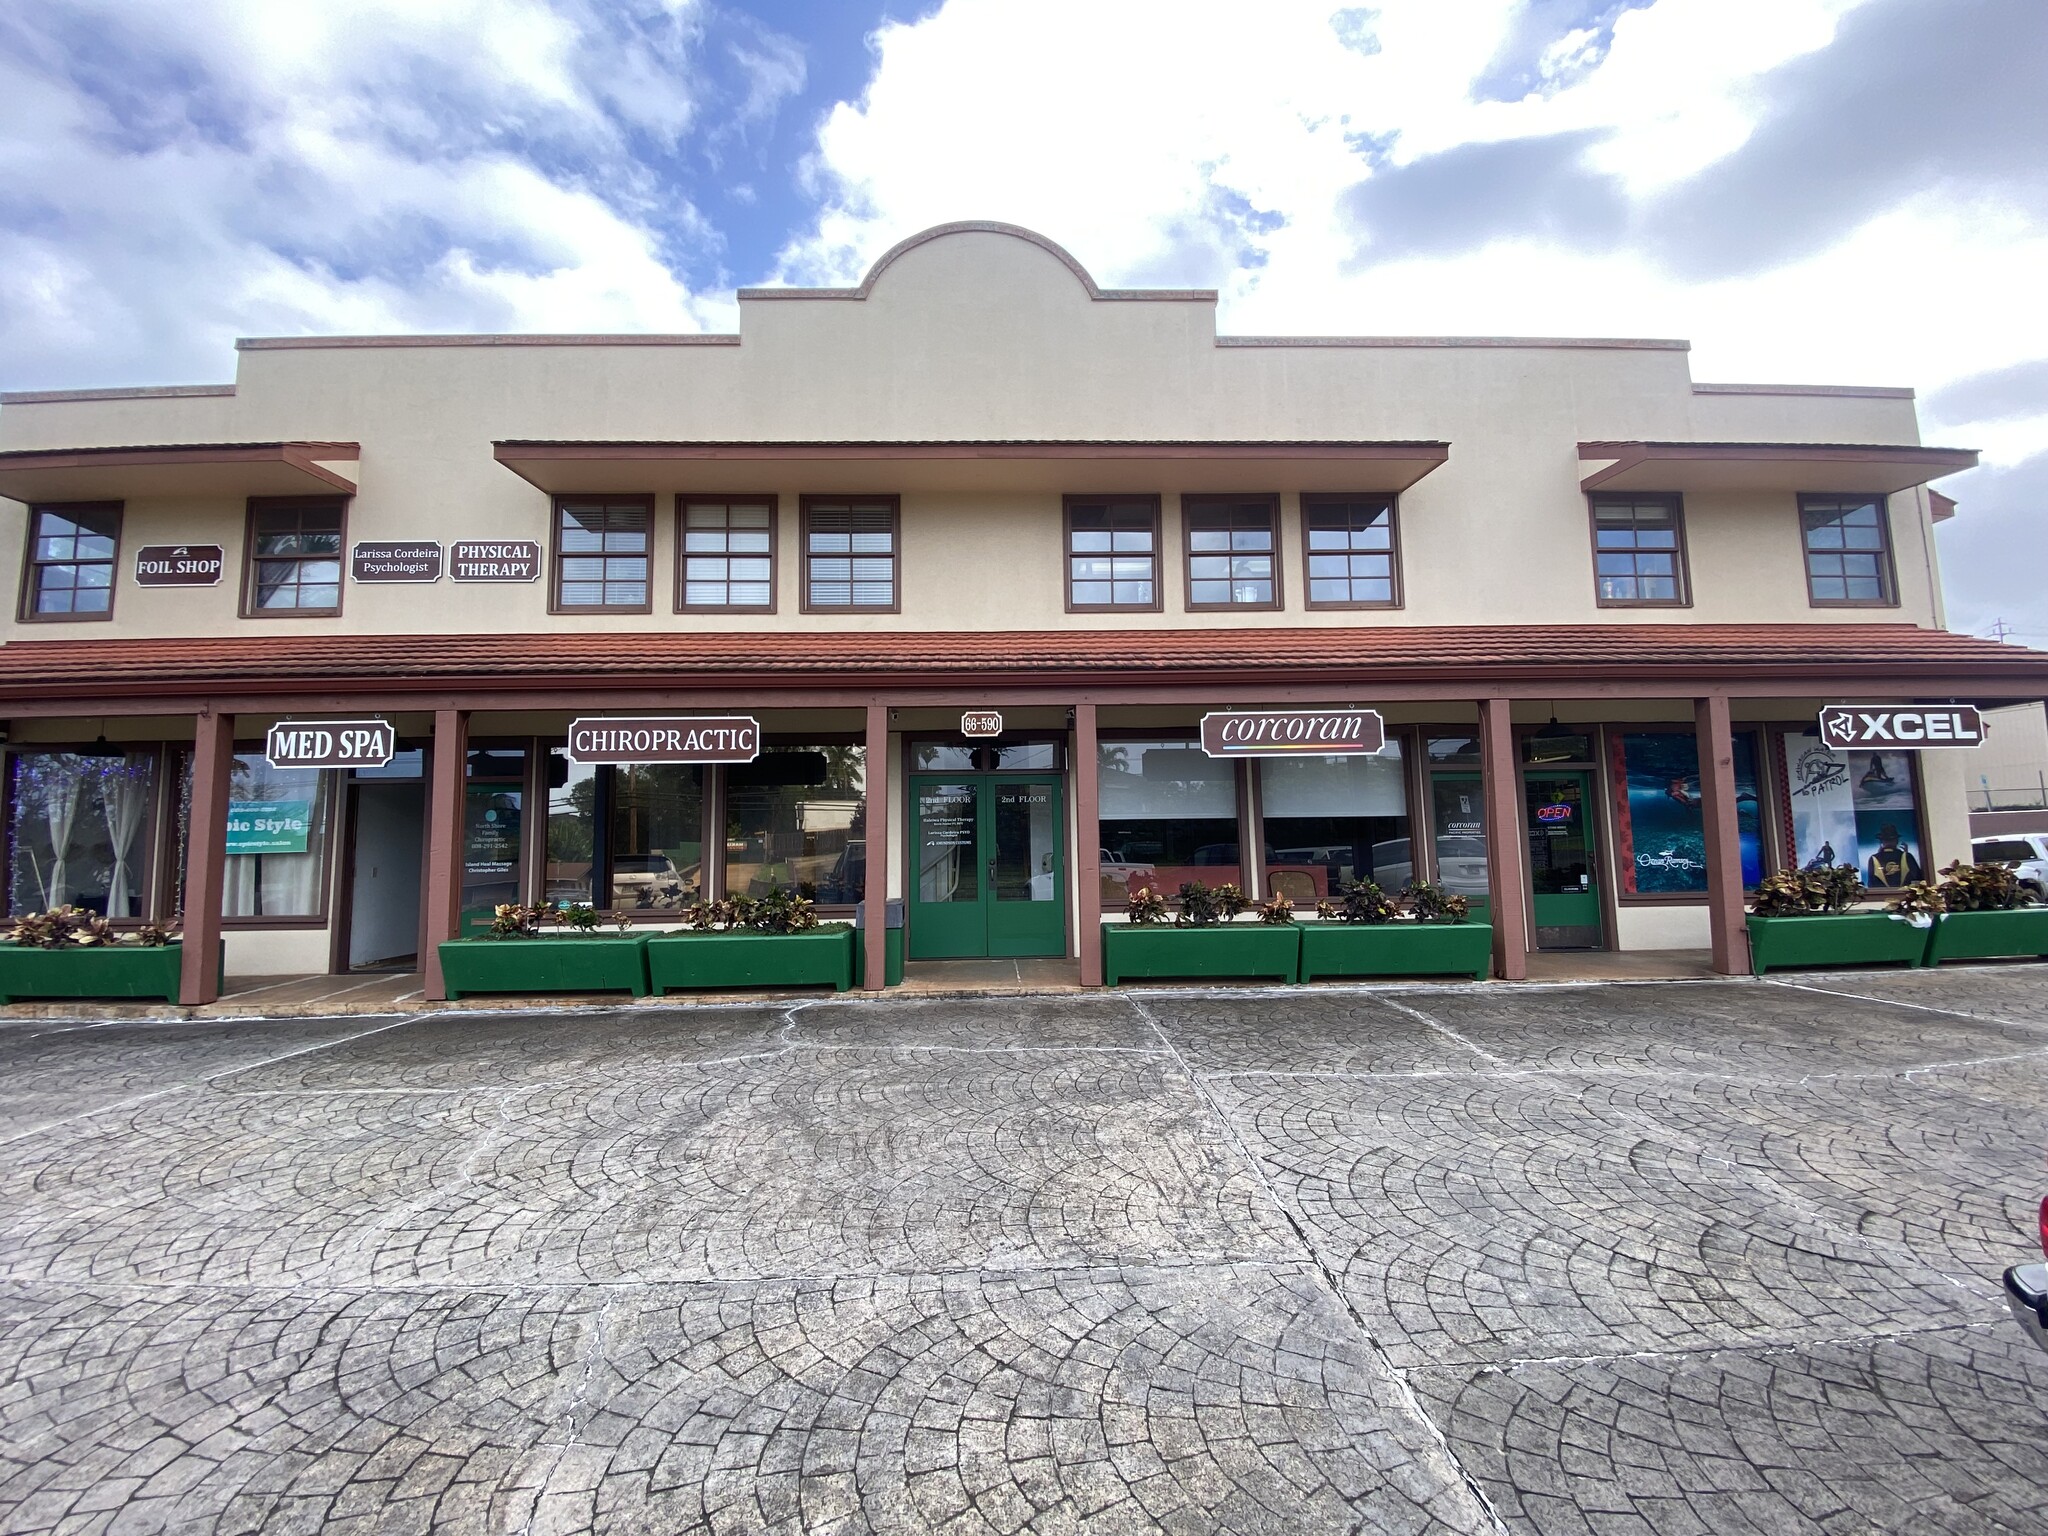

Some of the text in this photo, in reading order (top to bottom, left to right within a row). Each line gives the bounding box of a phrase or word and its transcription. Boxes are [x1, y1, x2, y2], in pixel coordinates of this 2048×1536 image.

[355, 549, 439, 558] Larissa Cordeira
[458, 546, 531, 558] PHYSICAL
[138, 560, 221, 574] FOIL SHOP
[364, 562, 429, 574] Psychologist
[458, 563, 530, 576] THERAPY
[965, 717, 999, 731] 66-590
[1221, 716, 1362, 741] corcoran
[1858, 713, 1978, 740] XCEL
[274, 730, 386, 759] MED SPA
[575, 729, 753, 751] CHIROPRACTIC
[1811, 774, 1850, 796] PATROL
[1019, 795, 1046, 803] FLOOR
[1537, 807, 1571, 818] OPEN
[254, 817, 303, 835] Style
